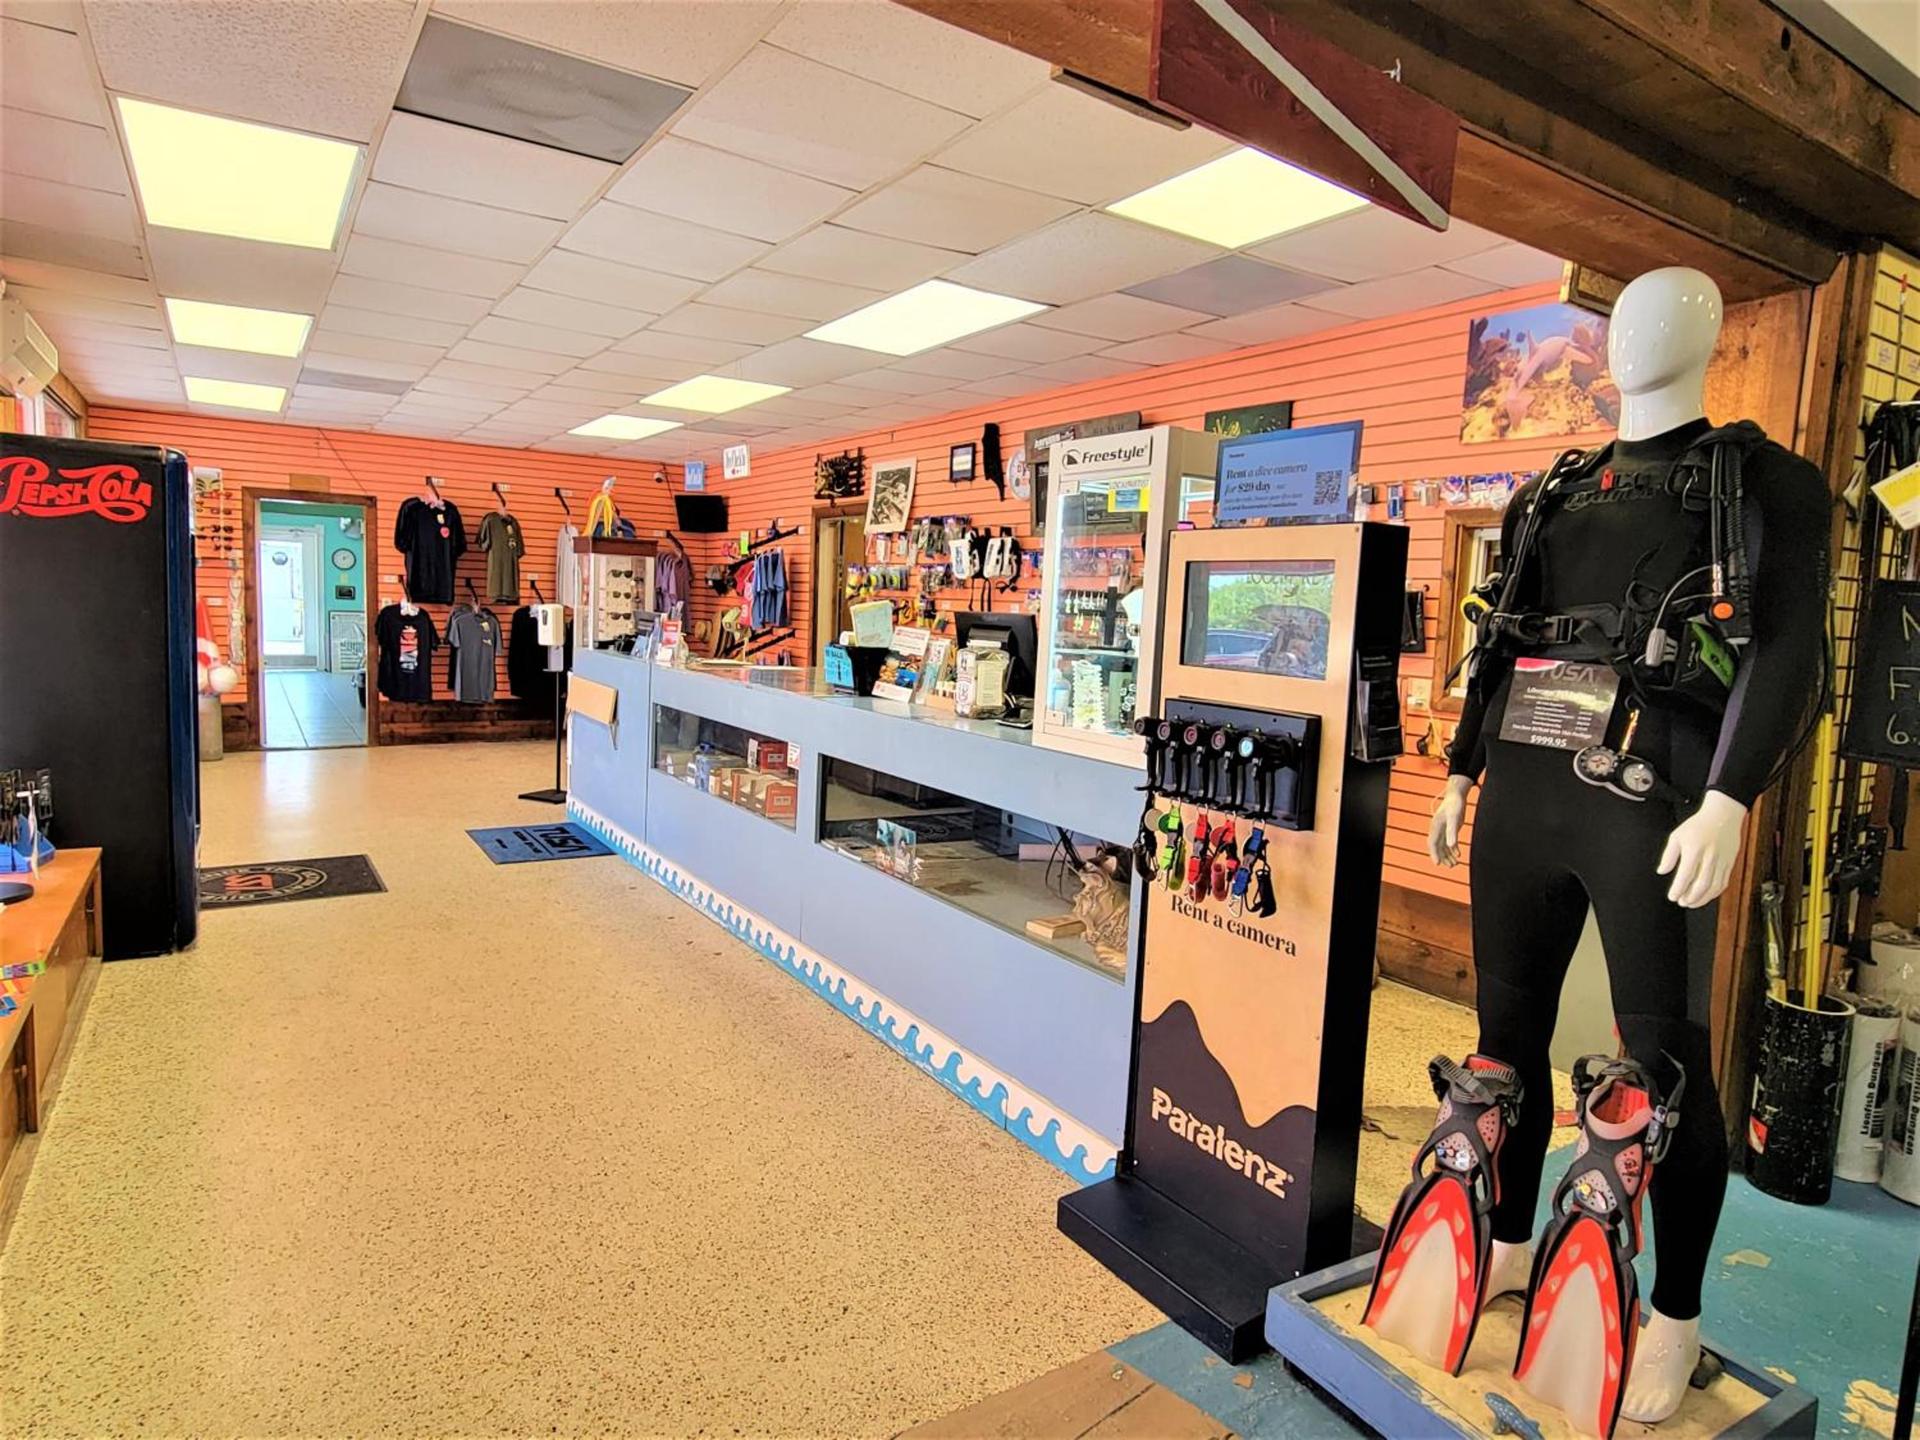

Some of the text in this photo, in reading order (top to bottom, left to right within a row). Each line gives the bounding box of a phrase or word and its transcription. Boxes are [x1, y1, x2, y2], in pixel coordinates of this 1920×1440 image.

[1081, 447, 1145, 465] Freestyle
[1530, 734, 1567, 747] $999.95
[1171, 894, 1297, 957] Rent a camera
[1860, 1091, 1875, 1136] Lionfish
[1151, 1086, 1288, 1200] Paralenz
